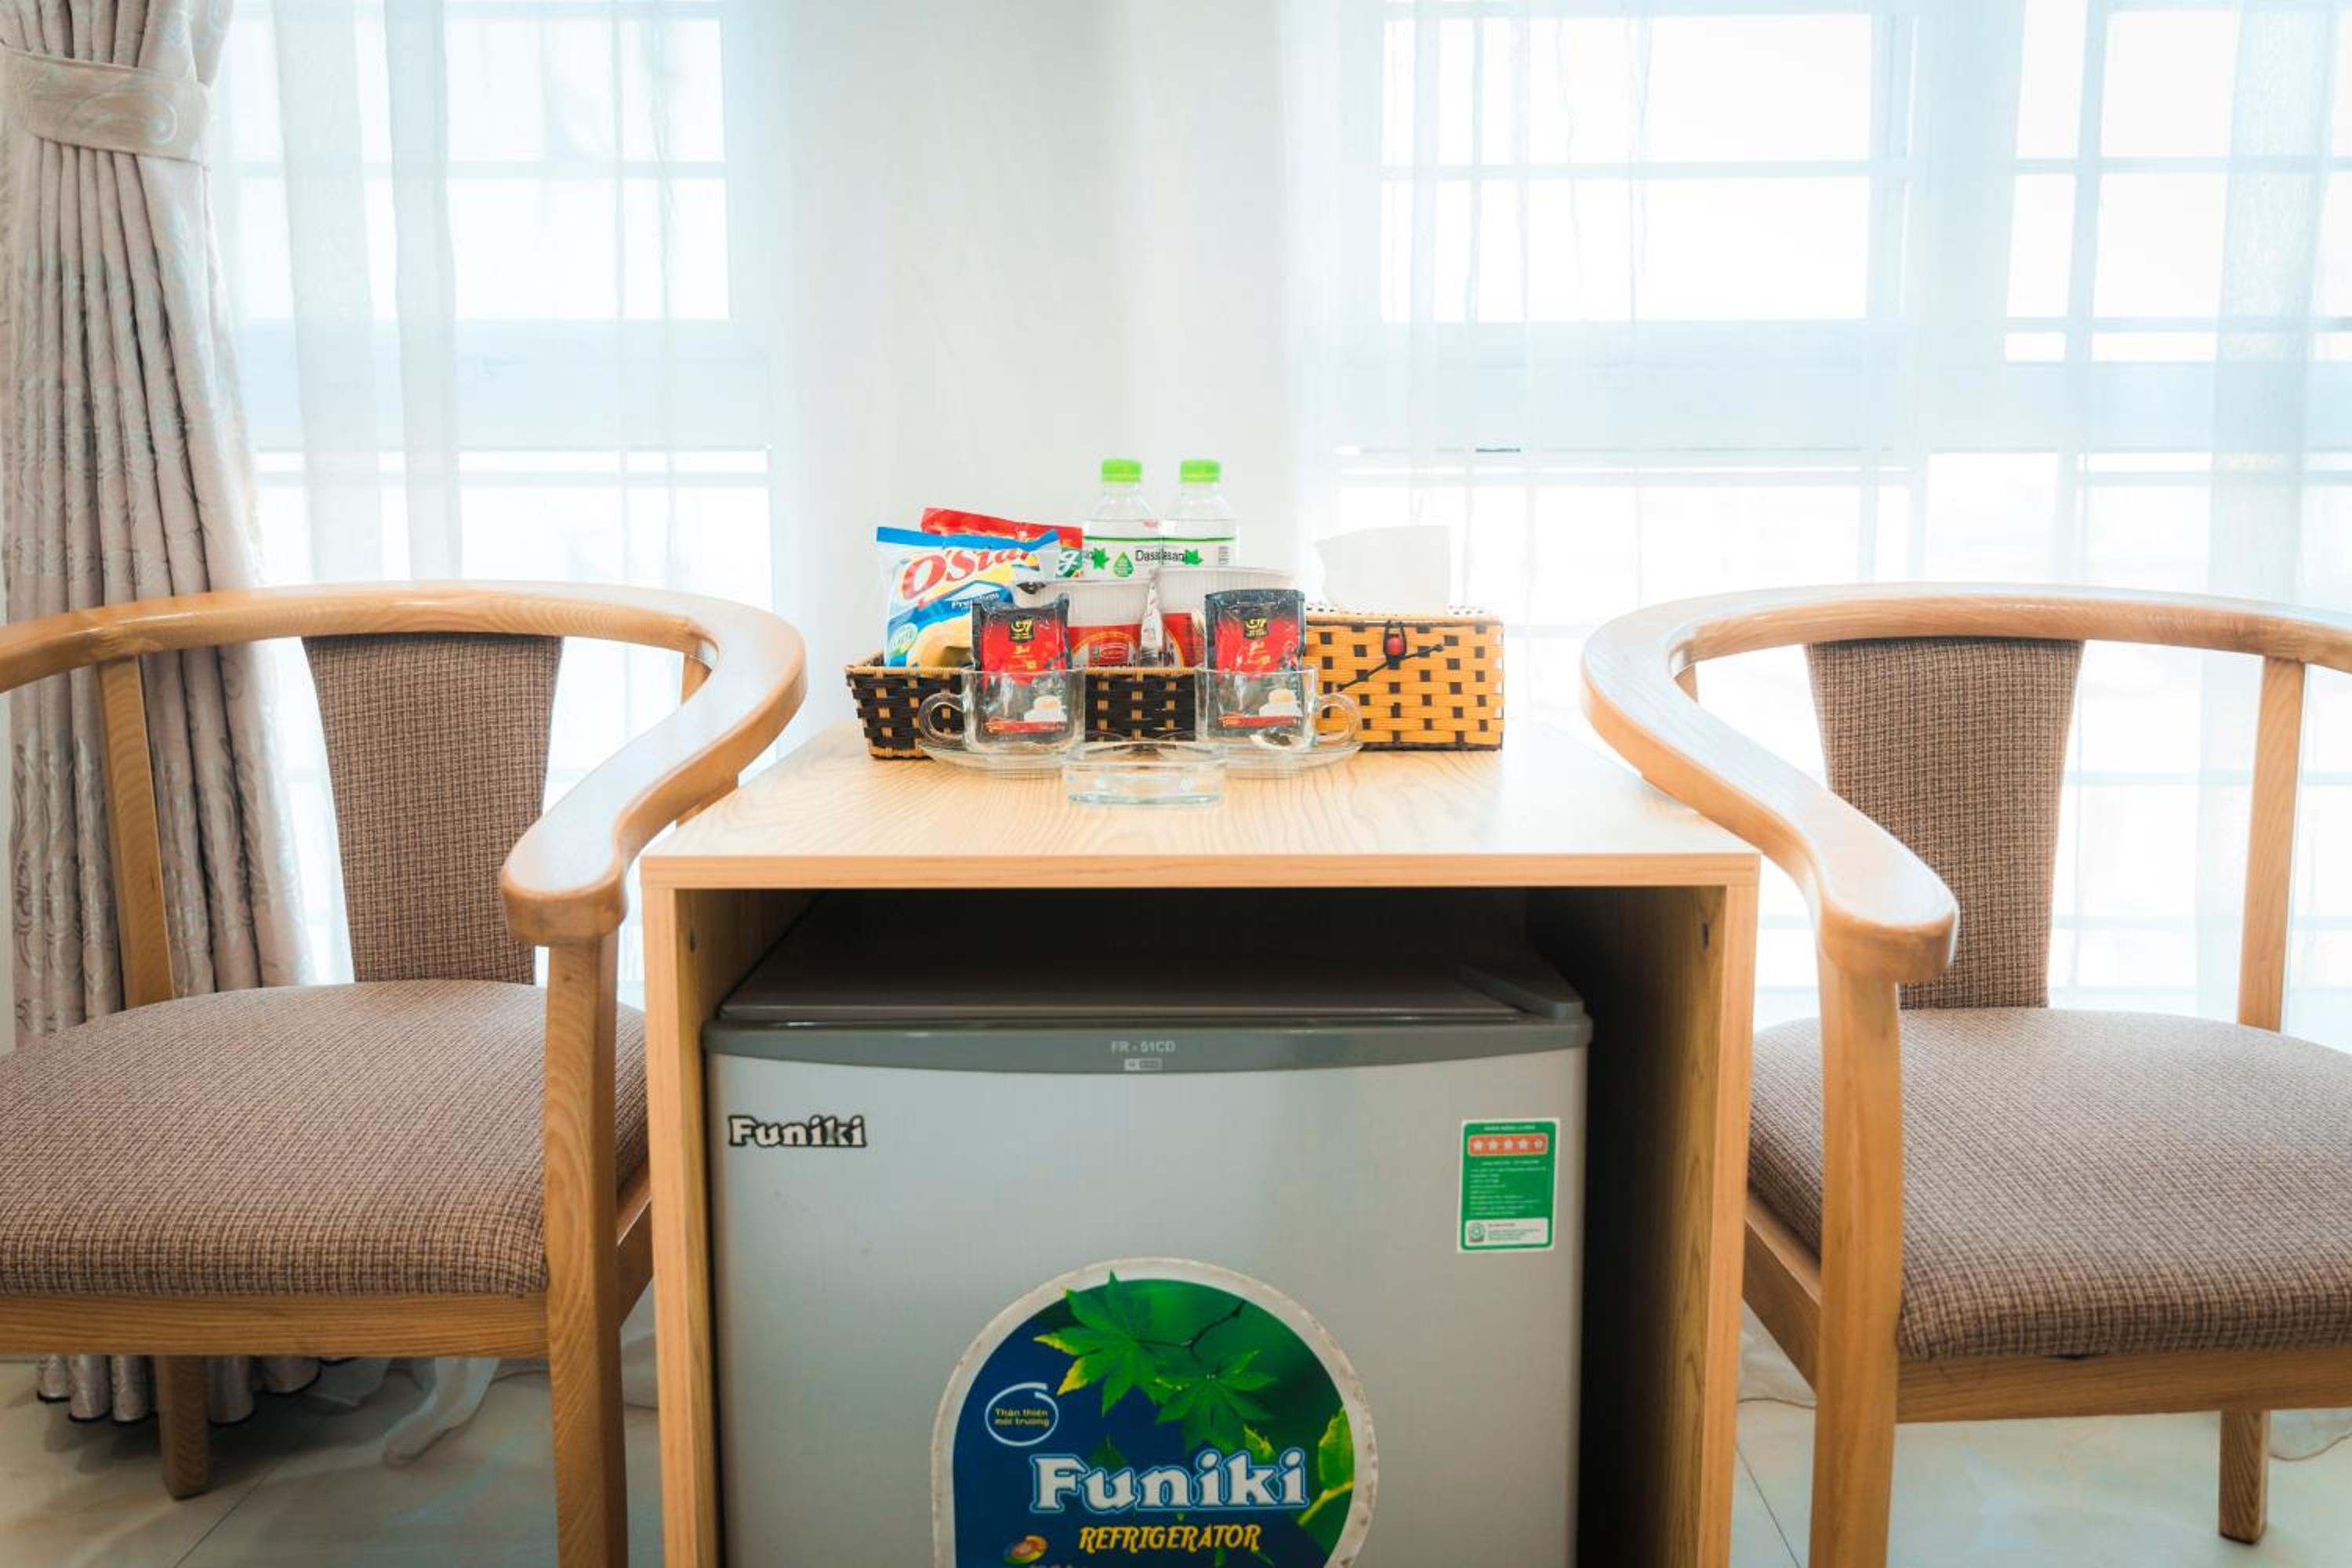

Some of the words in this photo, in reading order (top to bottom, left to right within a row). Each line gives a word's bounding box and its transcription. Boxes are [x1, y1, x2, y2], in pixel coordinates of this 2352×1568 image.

[1110, 1040, 1130, 1052] FR
[728, 1114, 867, 1148] Funiki
[1029, 1447, 1310, 1515] Funiki
[1079, 1524, 1261, 1554] REFRIGERATOR
